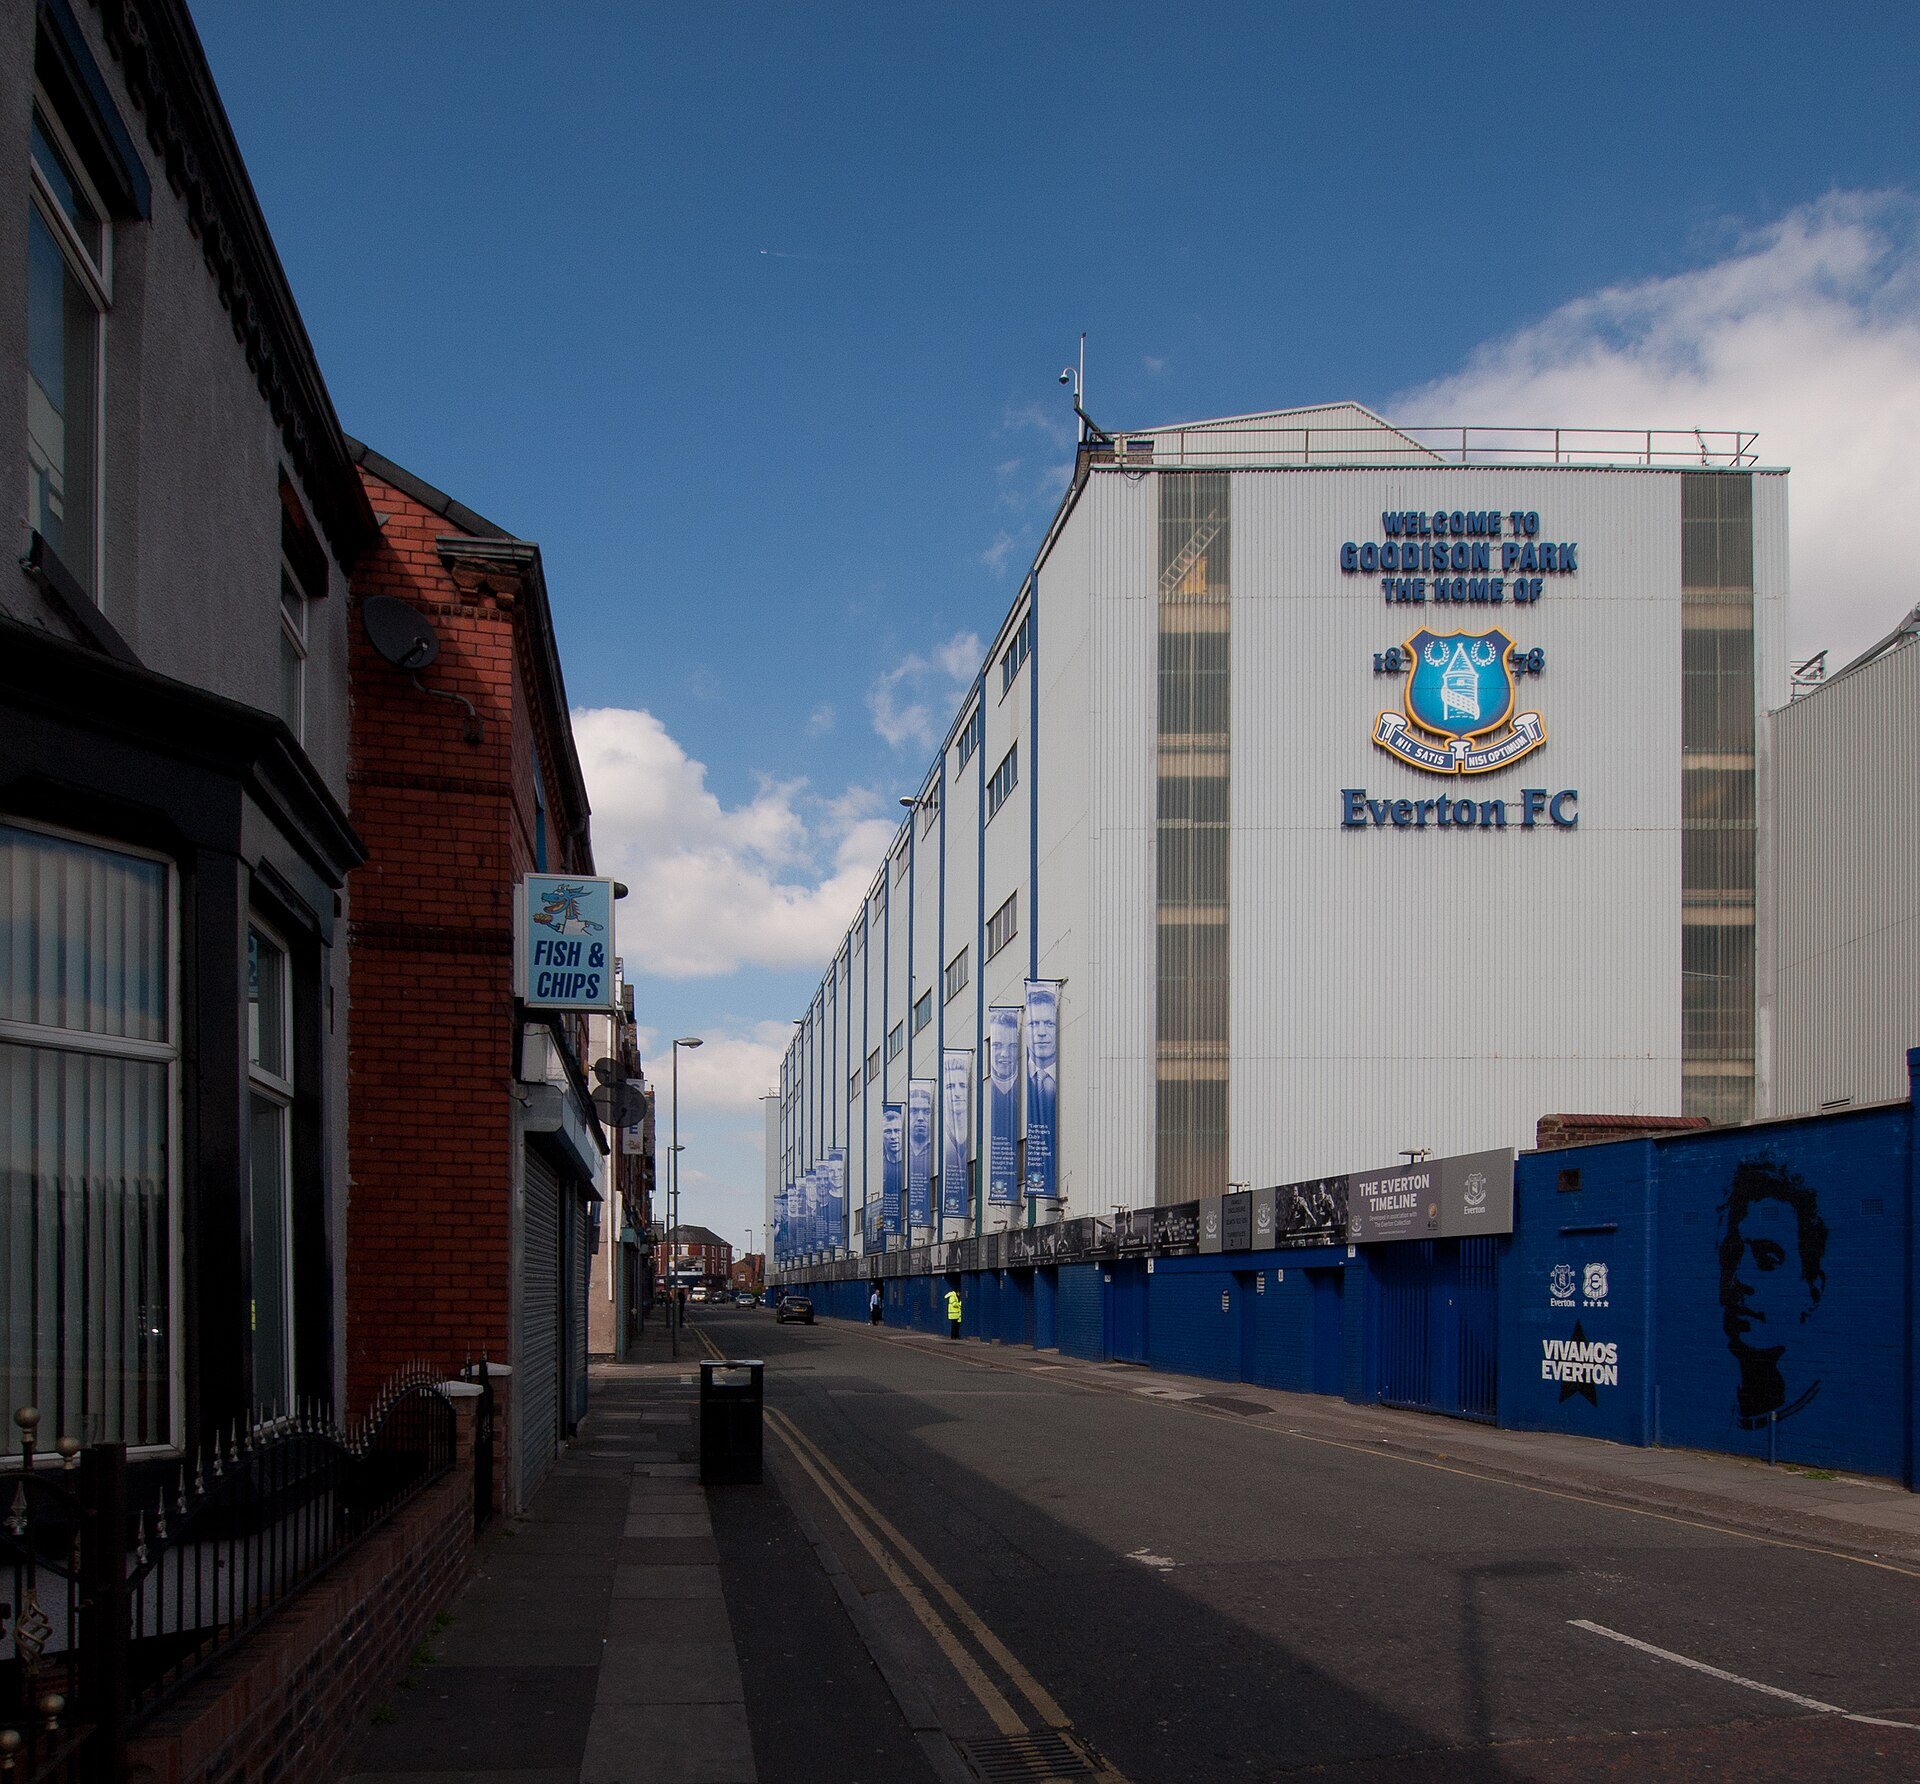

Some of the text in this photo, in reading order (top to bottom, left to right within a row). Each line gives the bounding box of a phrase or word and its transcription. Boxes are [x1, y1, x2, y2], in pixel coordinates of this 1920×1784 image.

[1382, 511, 1539, 534] WELCOME TO
[1340, 542, 1578, 571] GOODISON PARK
[1381, 577, 1543, 602] THE HOME OF
[1514, 647, 1545, 677] 78
[1395, 735, 1528, 767] NIL SATIS NISI OPTIMUM
[1341, 789, 1578, 826] Everton FC
[534, 940, 604, 968] FISH &
[537, 971, 600, 999] CHIPS
[1359, 1174, 1430, 1197] THE EVERTON
[1369, 1193, 1417, 1212] TIMELINE
[1463, 1205, 1485, 1215] Everton
[1550, 1298, 1576, 1307] Everton
[1542, 1339, 1618, 1365] VIVAMOS
[1542, 1360, 1618, 1386] EVERTON
